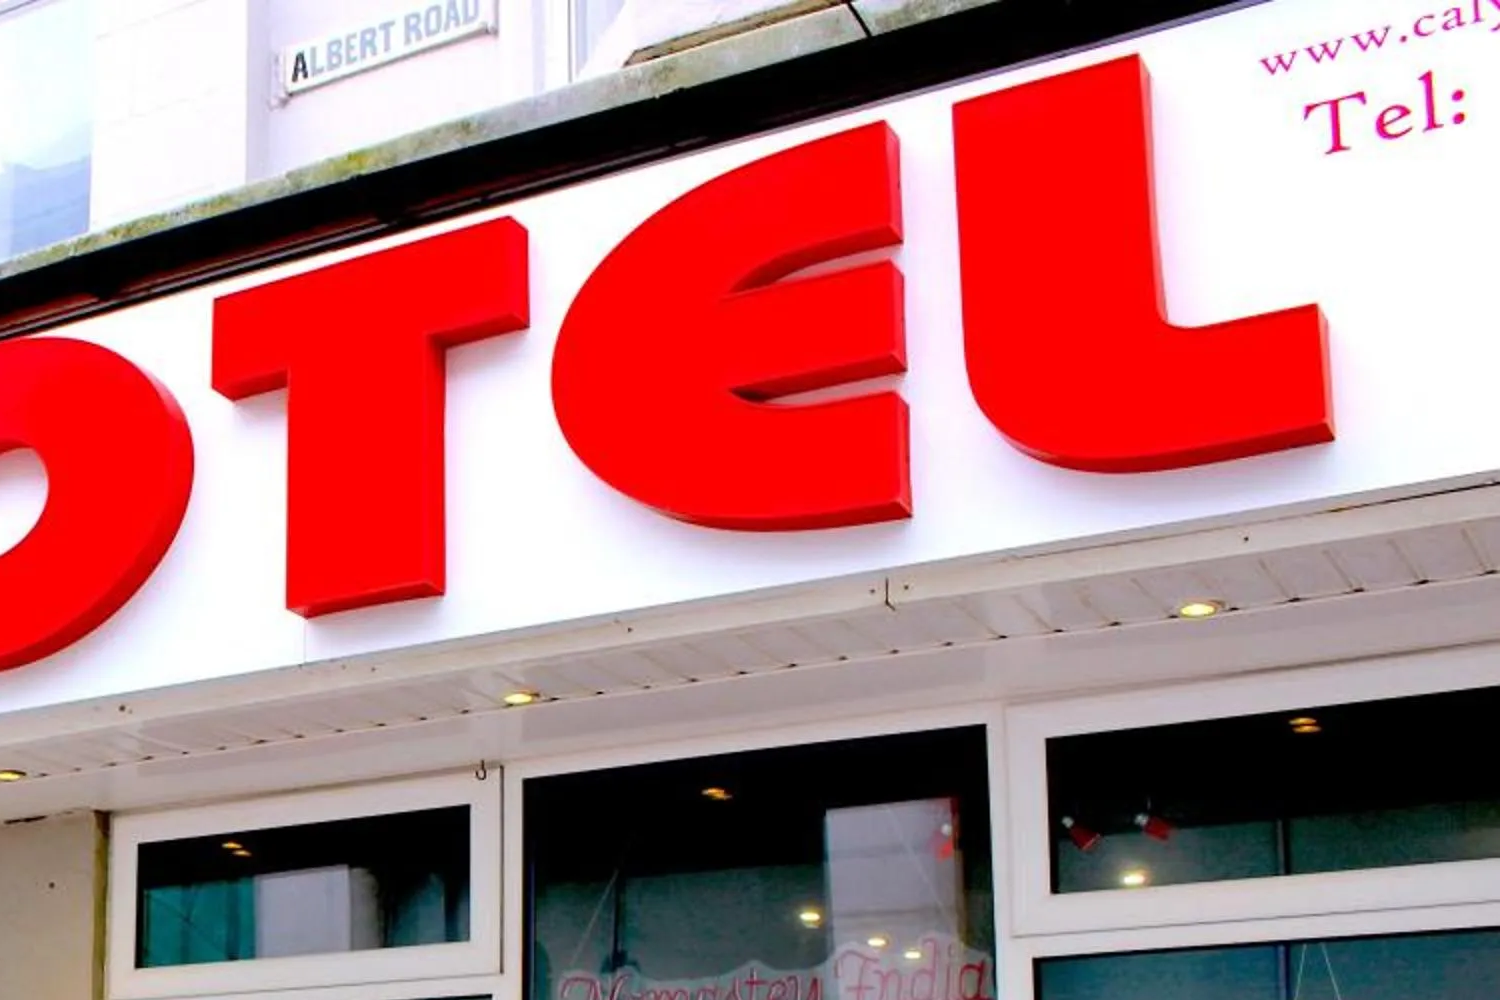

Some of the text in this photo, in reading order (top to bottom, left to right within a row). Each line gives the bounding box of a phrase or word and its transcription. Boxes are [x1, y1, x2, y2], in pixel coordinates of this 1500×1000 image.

[291, 0, 480, 83] ALBERT ROAD
[1302, 70, 1467, 155] Tel:
